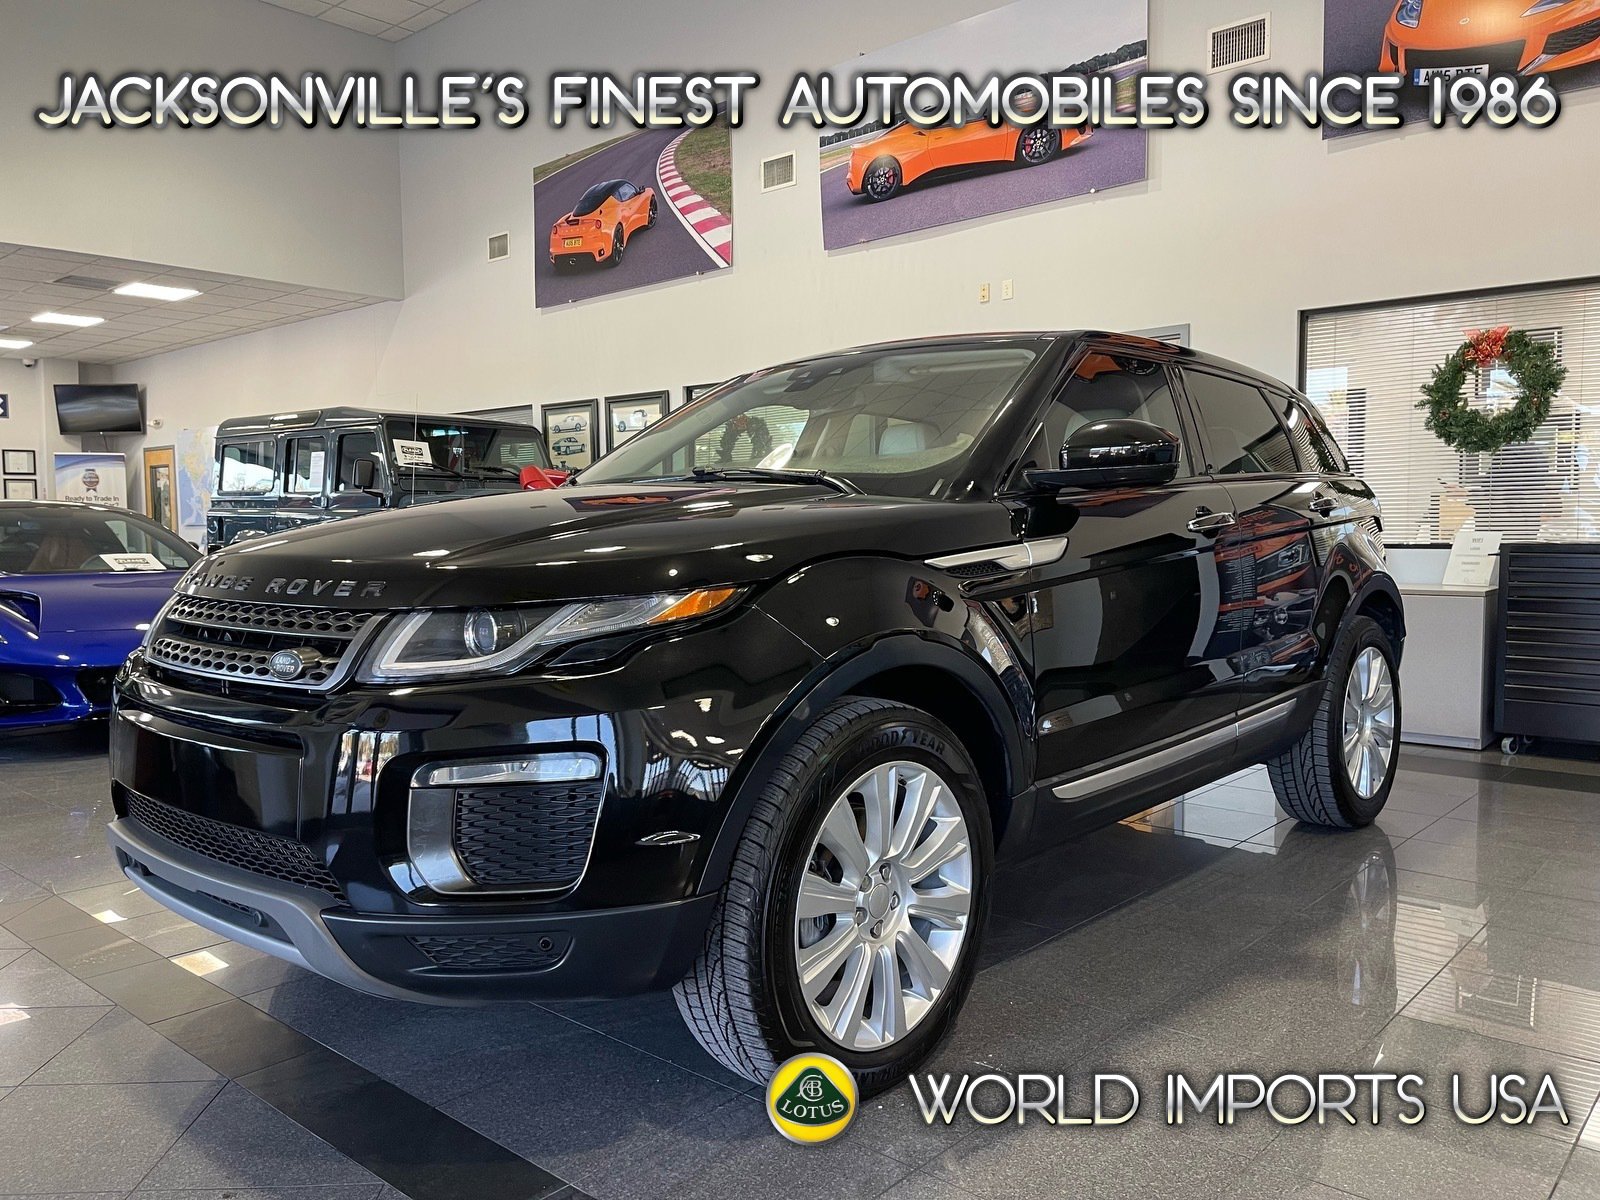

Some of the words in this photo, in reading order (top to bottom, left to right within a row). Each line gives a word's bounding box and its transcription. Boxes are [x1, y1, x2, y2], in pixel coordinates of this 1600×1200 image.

[264, 576, 387, 599] ROVER
[275, 656, 292, 664] LAND
[276, 664, 295, 673] ROVER
